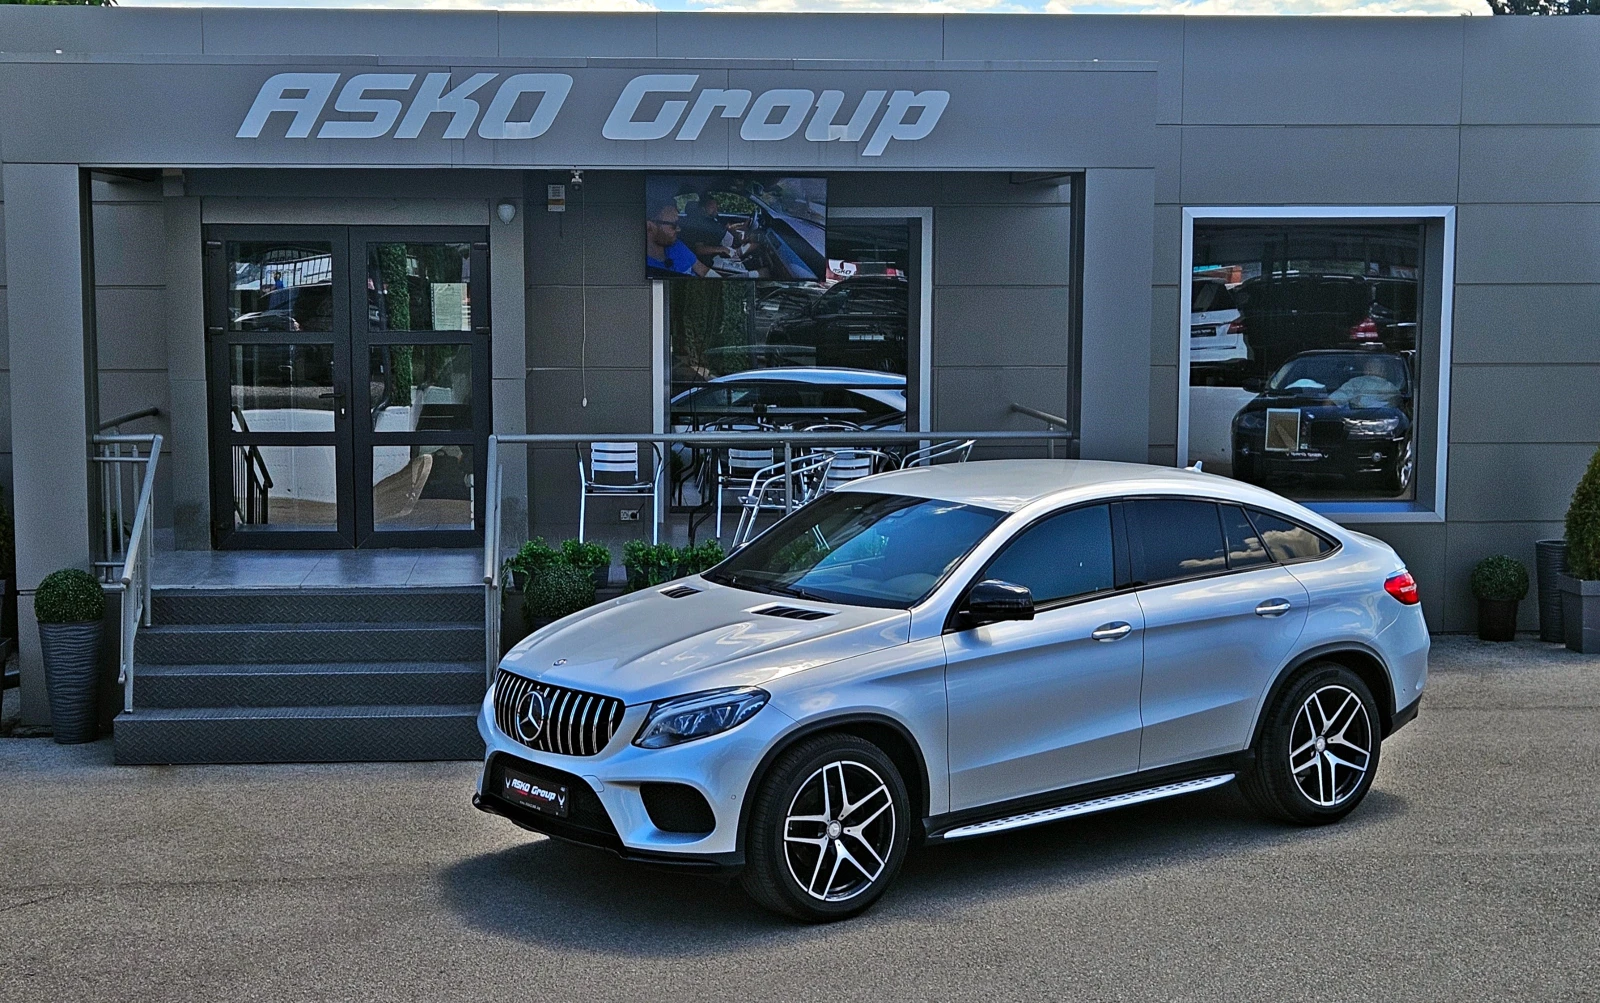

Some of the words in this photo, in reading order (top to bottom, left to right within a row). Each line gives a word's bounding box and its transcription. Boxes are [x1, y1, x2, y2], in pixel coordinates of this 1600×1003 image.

[236, 73, 573, 139] ASKO
[602, 75, 951, 156] Group
[511, 778, 531, 792] ASKO
[531, 786, 556, 801] Group
